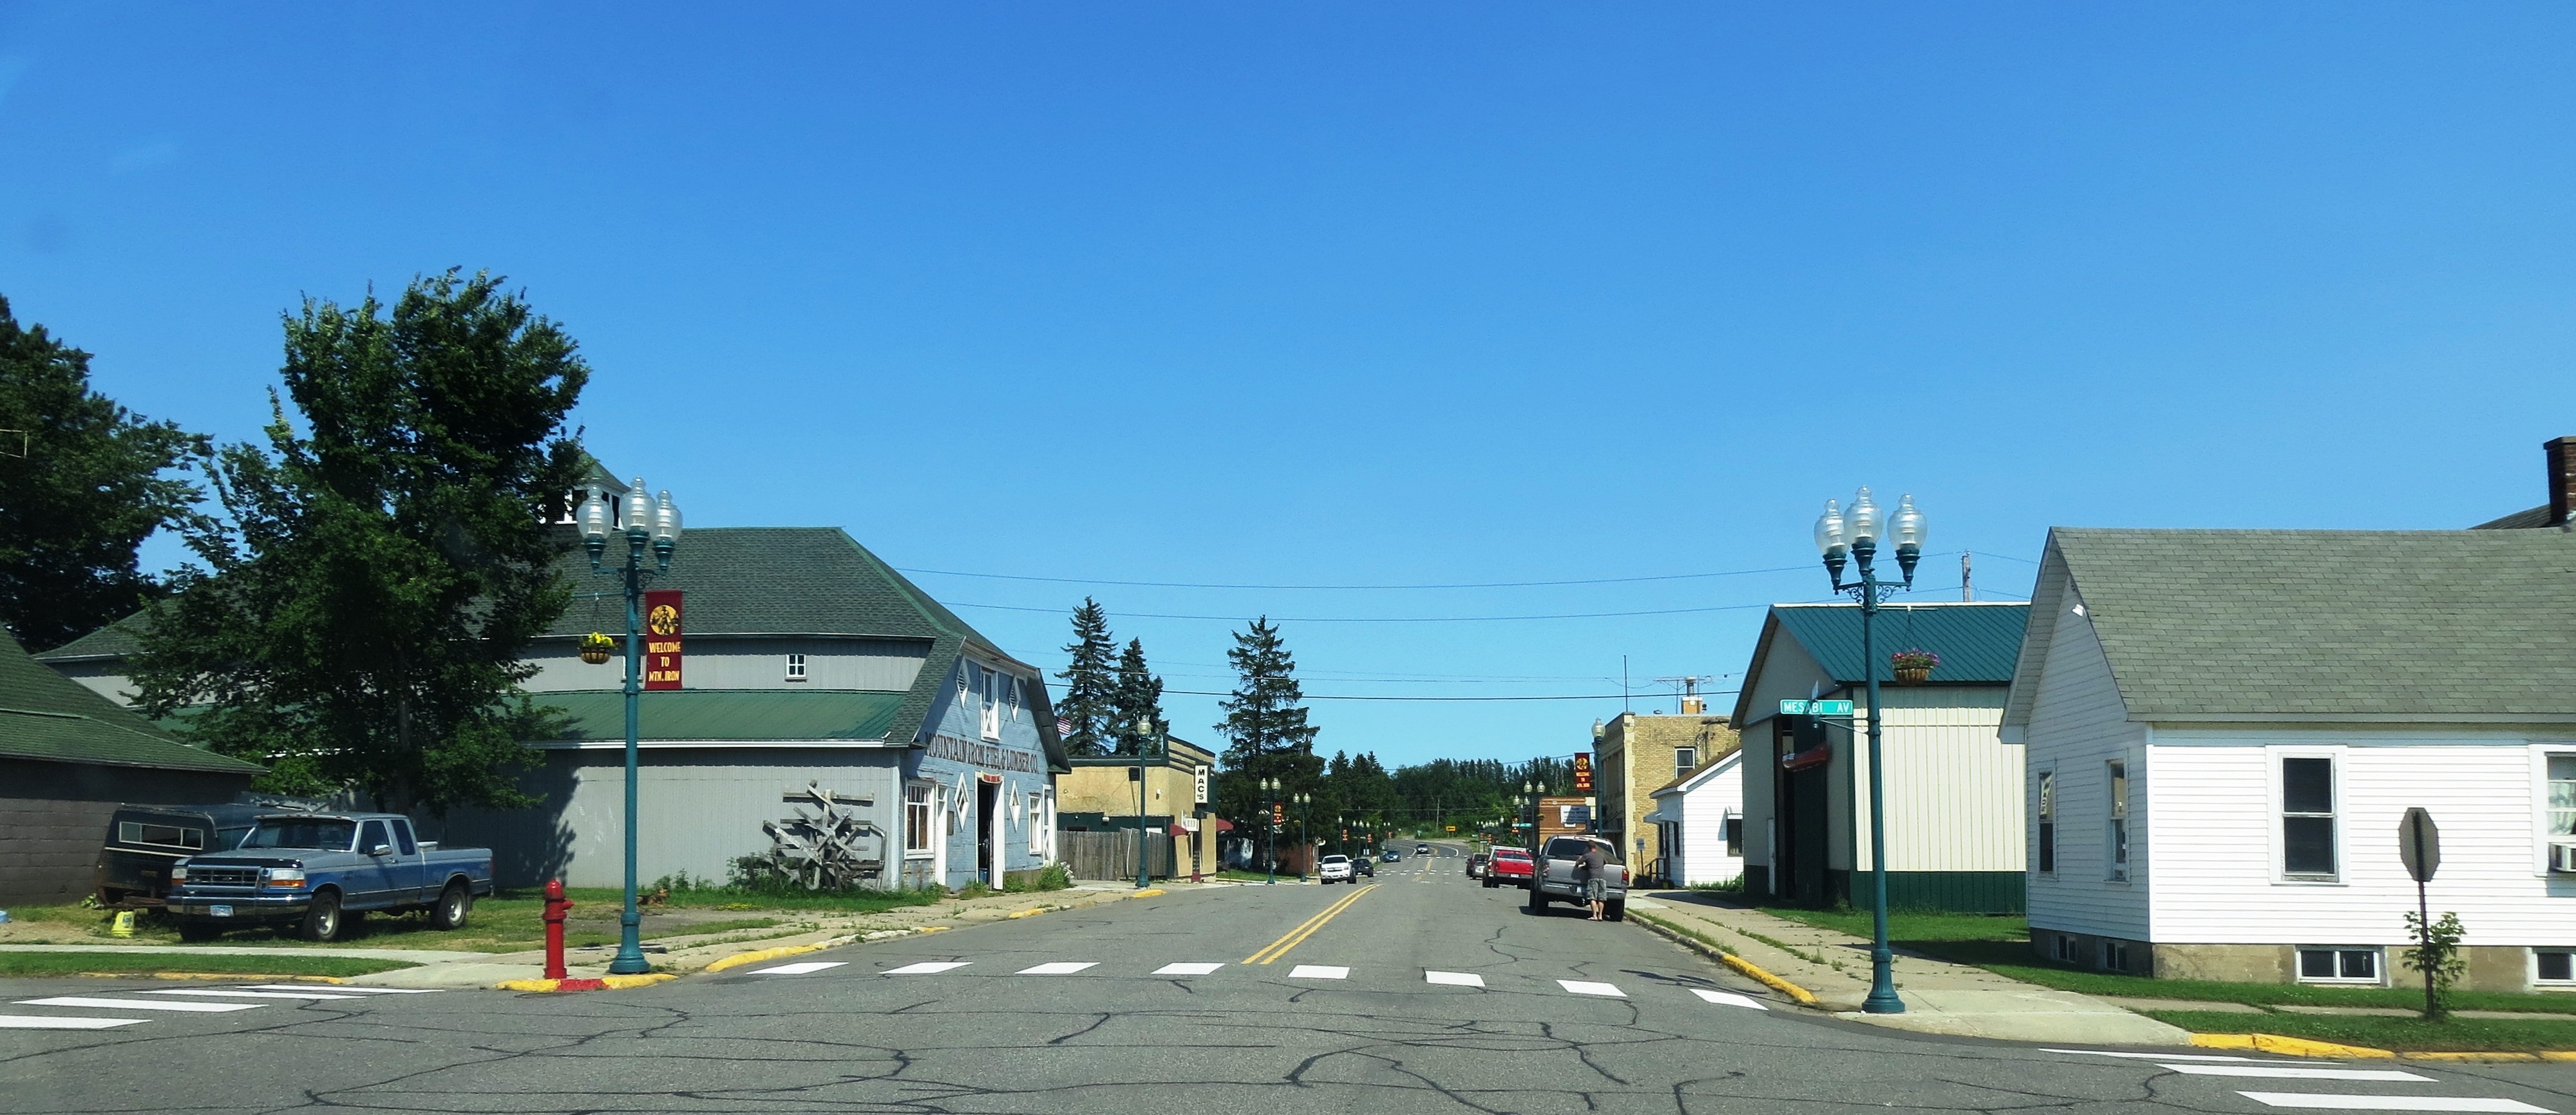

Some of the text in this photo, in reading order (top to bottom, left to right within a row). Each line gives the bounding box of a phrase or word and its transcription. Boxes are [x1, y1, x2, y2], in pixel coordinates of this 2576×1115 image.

[649, 641, 681, 653] WELCOME
[660, 657, 670, 667] TO
[649, 670, 679, 682] MTN. IRON
[1836, 702, 1850, 713] AV
[925, 732, 966, 763] MOUNTAIN
[968, 740, 985, 767] IRON
[1006, 749, 1030, 773] LUMBER
